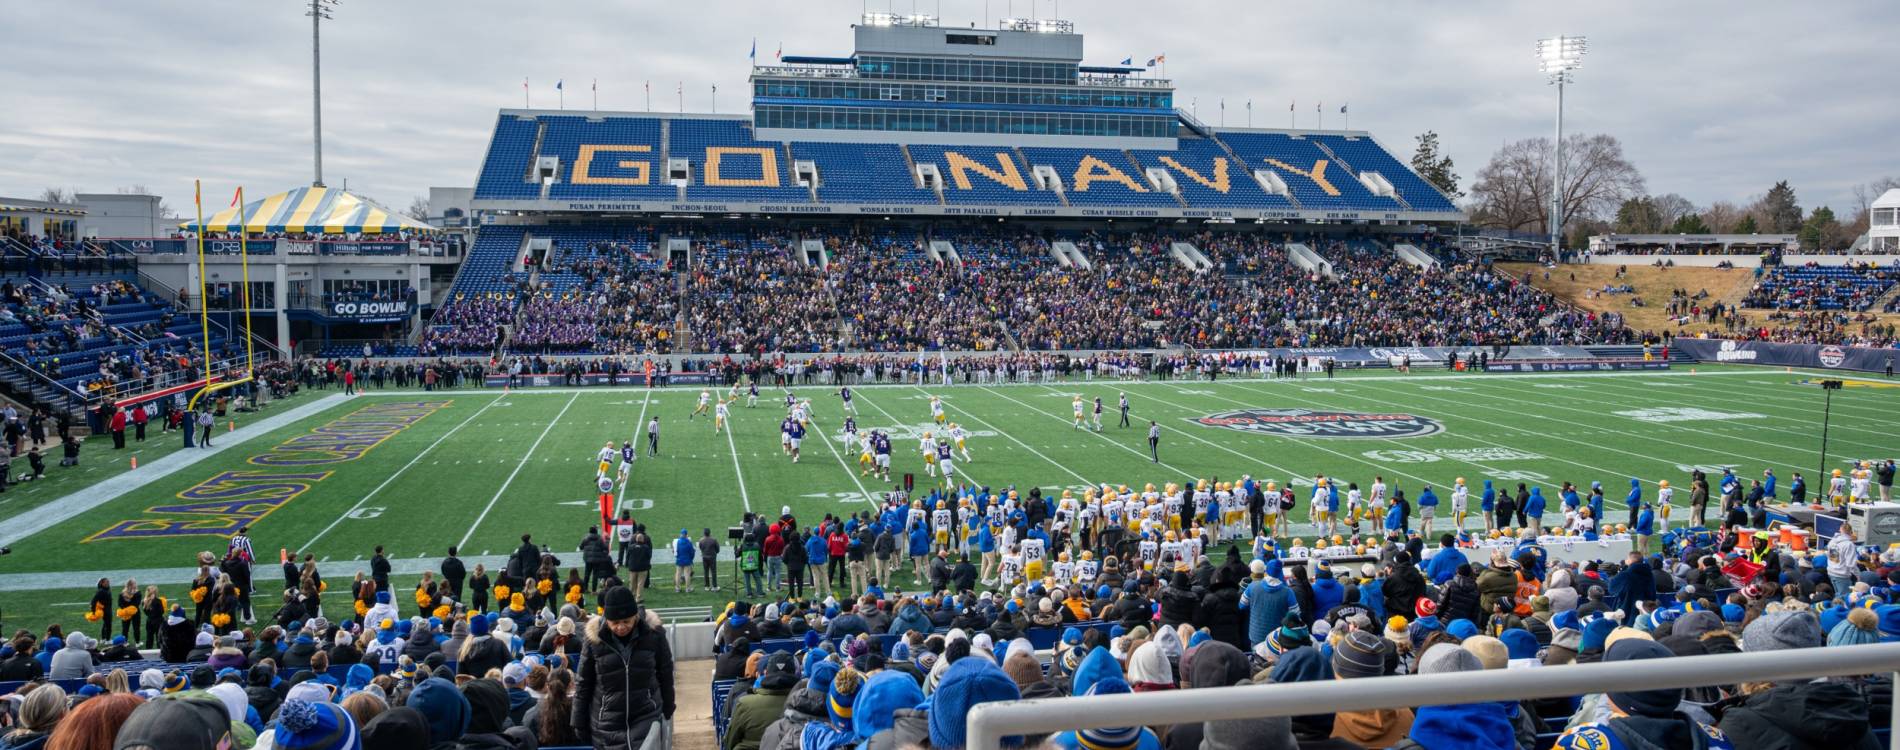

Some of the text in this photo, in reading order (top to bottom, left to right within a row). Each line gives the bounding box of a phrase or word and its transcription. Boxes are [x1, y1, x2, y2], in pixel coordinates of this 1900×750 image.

[571, 144, 1340, 196] GO NAVY
[597, 203, 641, 211] PERIMETER
[759, 205, 832, 213] CHOSIN RESERVOIR
[859, 206, 915, 214] WONSAN SIEGE
[132, 240, 154, 249] CACI
[212, 241, 241, 252] DRB
[335, 243, 359, 252] Hilton
[334, 303, 358, 314] GO
[1721, 340, 1736, 352] GO
[1716, 350, 1757, 361] BOWLING
[246, 399, 455, 467] CAROLINA
[79, 469, 336, 543] EAST
[1268, 497, 1278, 508] 64
[346, 506, 387, 519] G
[1171, 504, 1182, 513] 93
[937, 515, 949, 525] 22
[992, 512, 1001, 522] 18
[1026, 547, 1040, 559] 53
[1142, 549, 1154, 560] 60
[1059, 568, 1070, 578] 71
